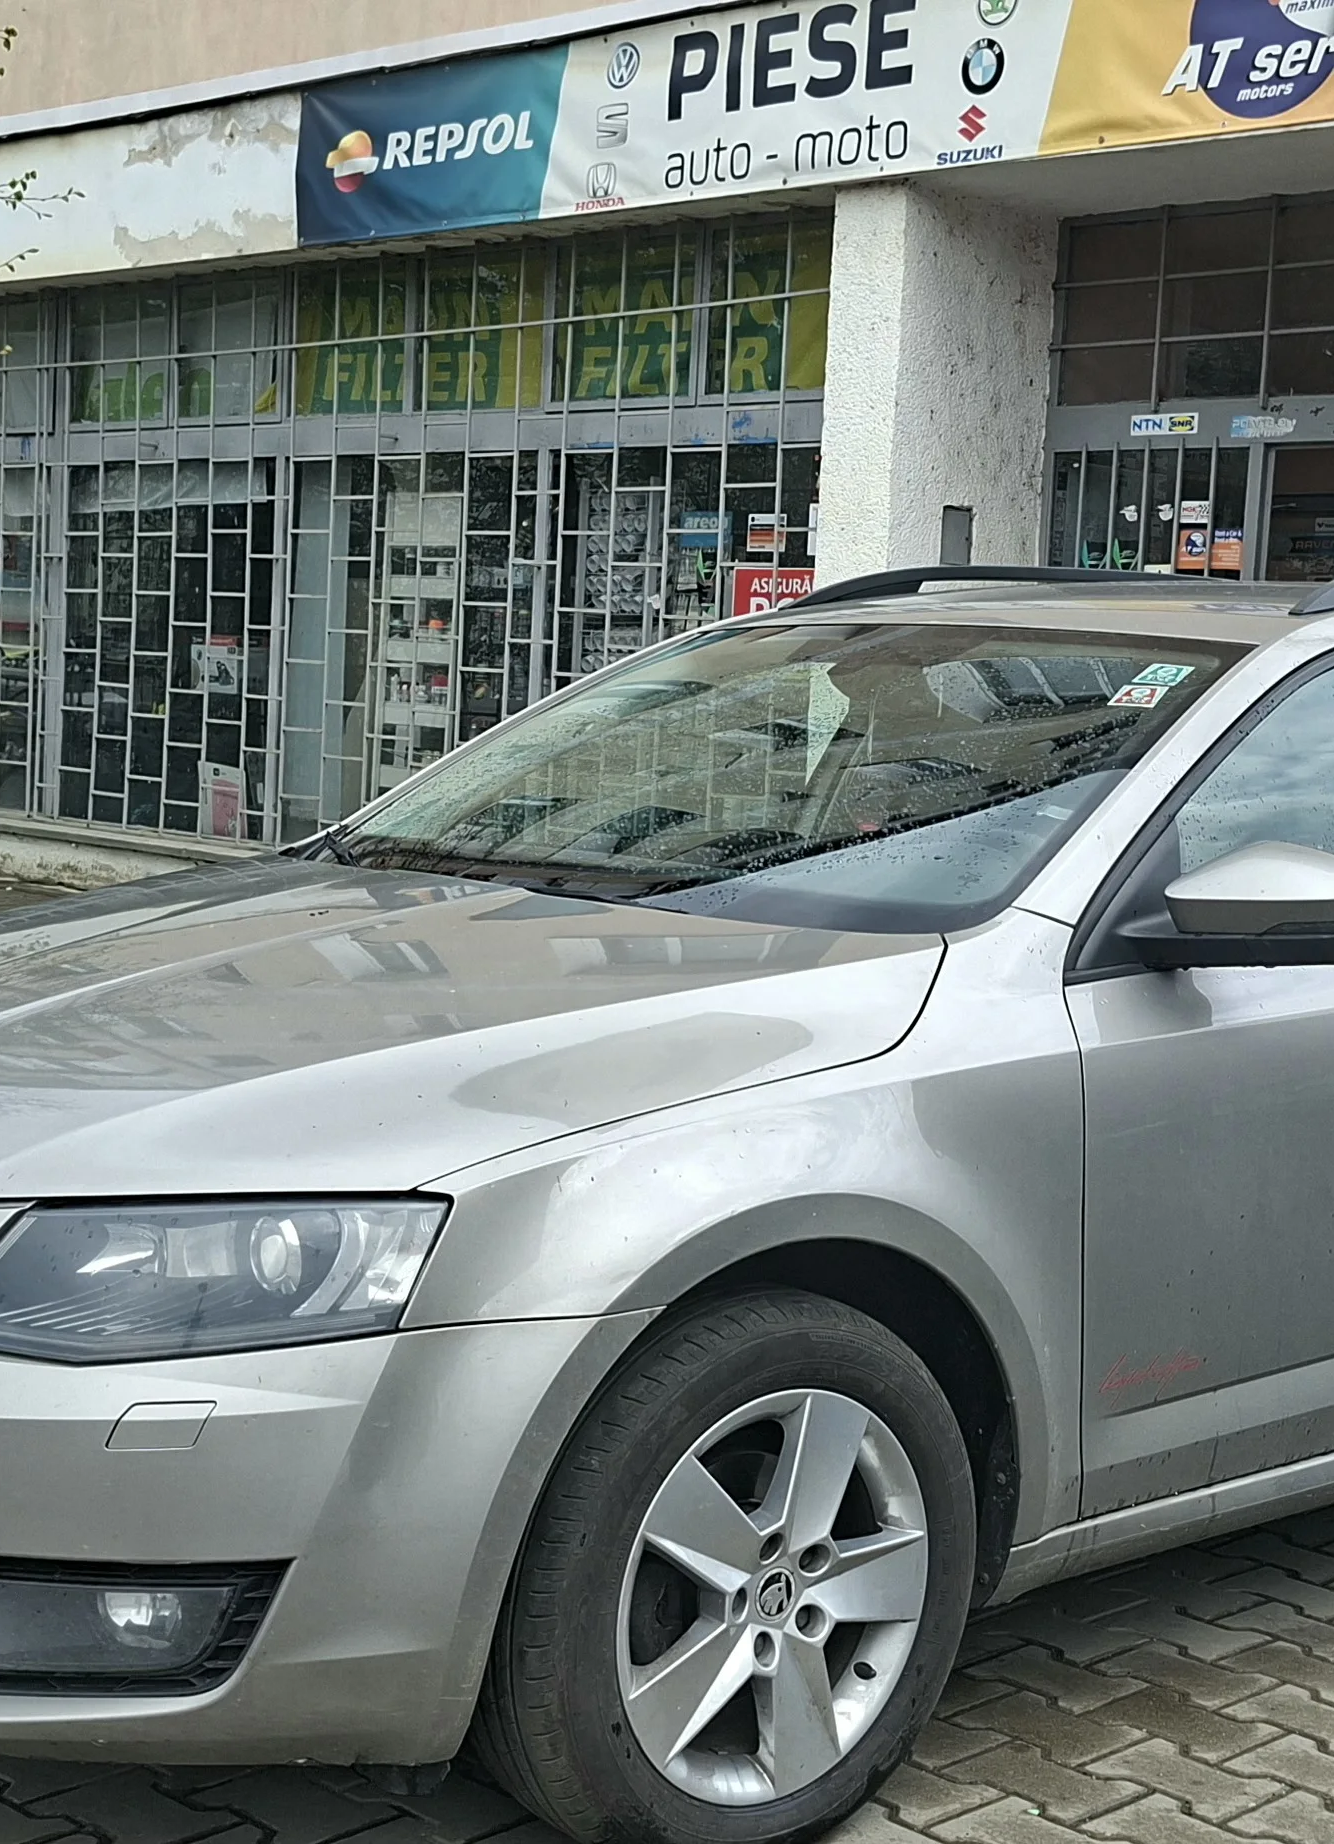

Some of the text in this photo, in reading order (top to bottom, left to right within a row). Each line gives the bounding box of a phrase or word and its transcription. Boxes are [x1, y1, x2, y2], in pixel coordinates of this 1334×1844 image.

[667, 0, 916, 122] PIESE
[1161, 36, 1245, 96] AT
[1236, 82, 1295, 102] motors
[383, 110, 534, 170] REPSOL
[665, 138, 751, 189] auto
[794, 115, 908, 172] moto
[936, 145, 1003, 165] SUZUKI
[575, 196, 626, 212] HONDA
[1132, 418, 1193, 432] NTN SNR
[750, 575, 813, 593] ASIGURĂ
